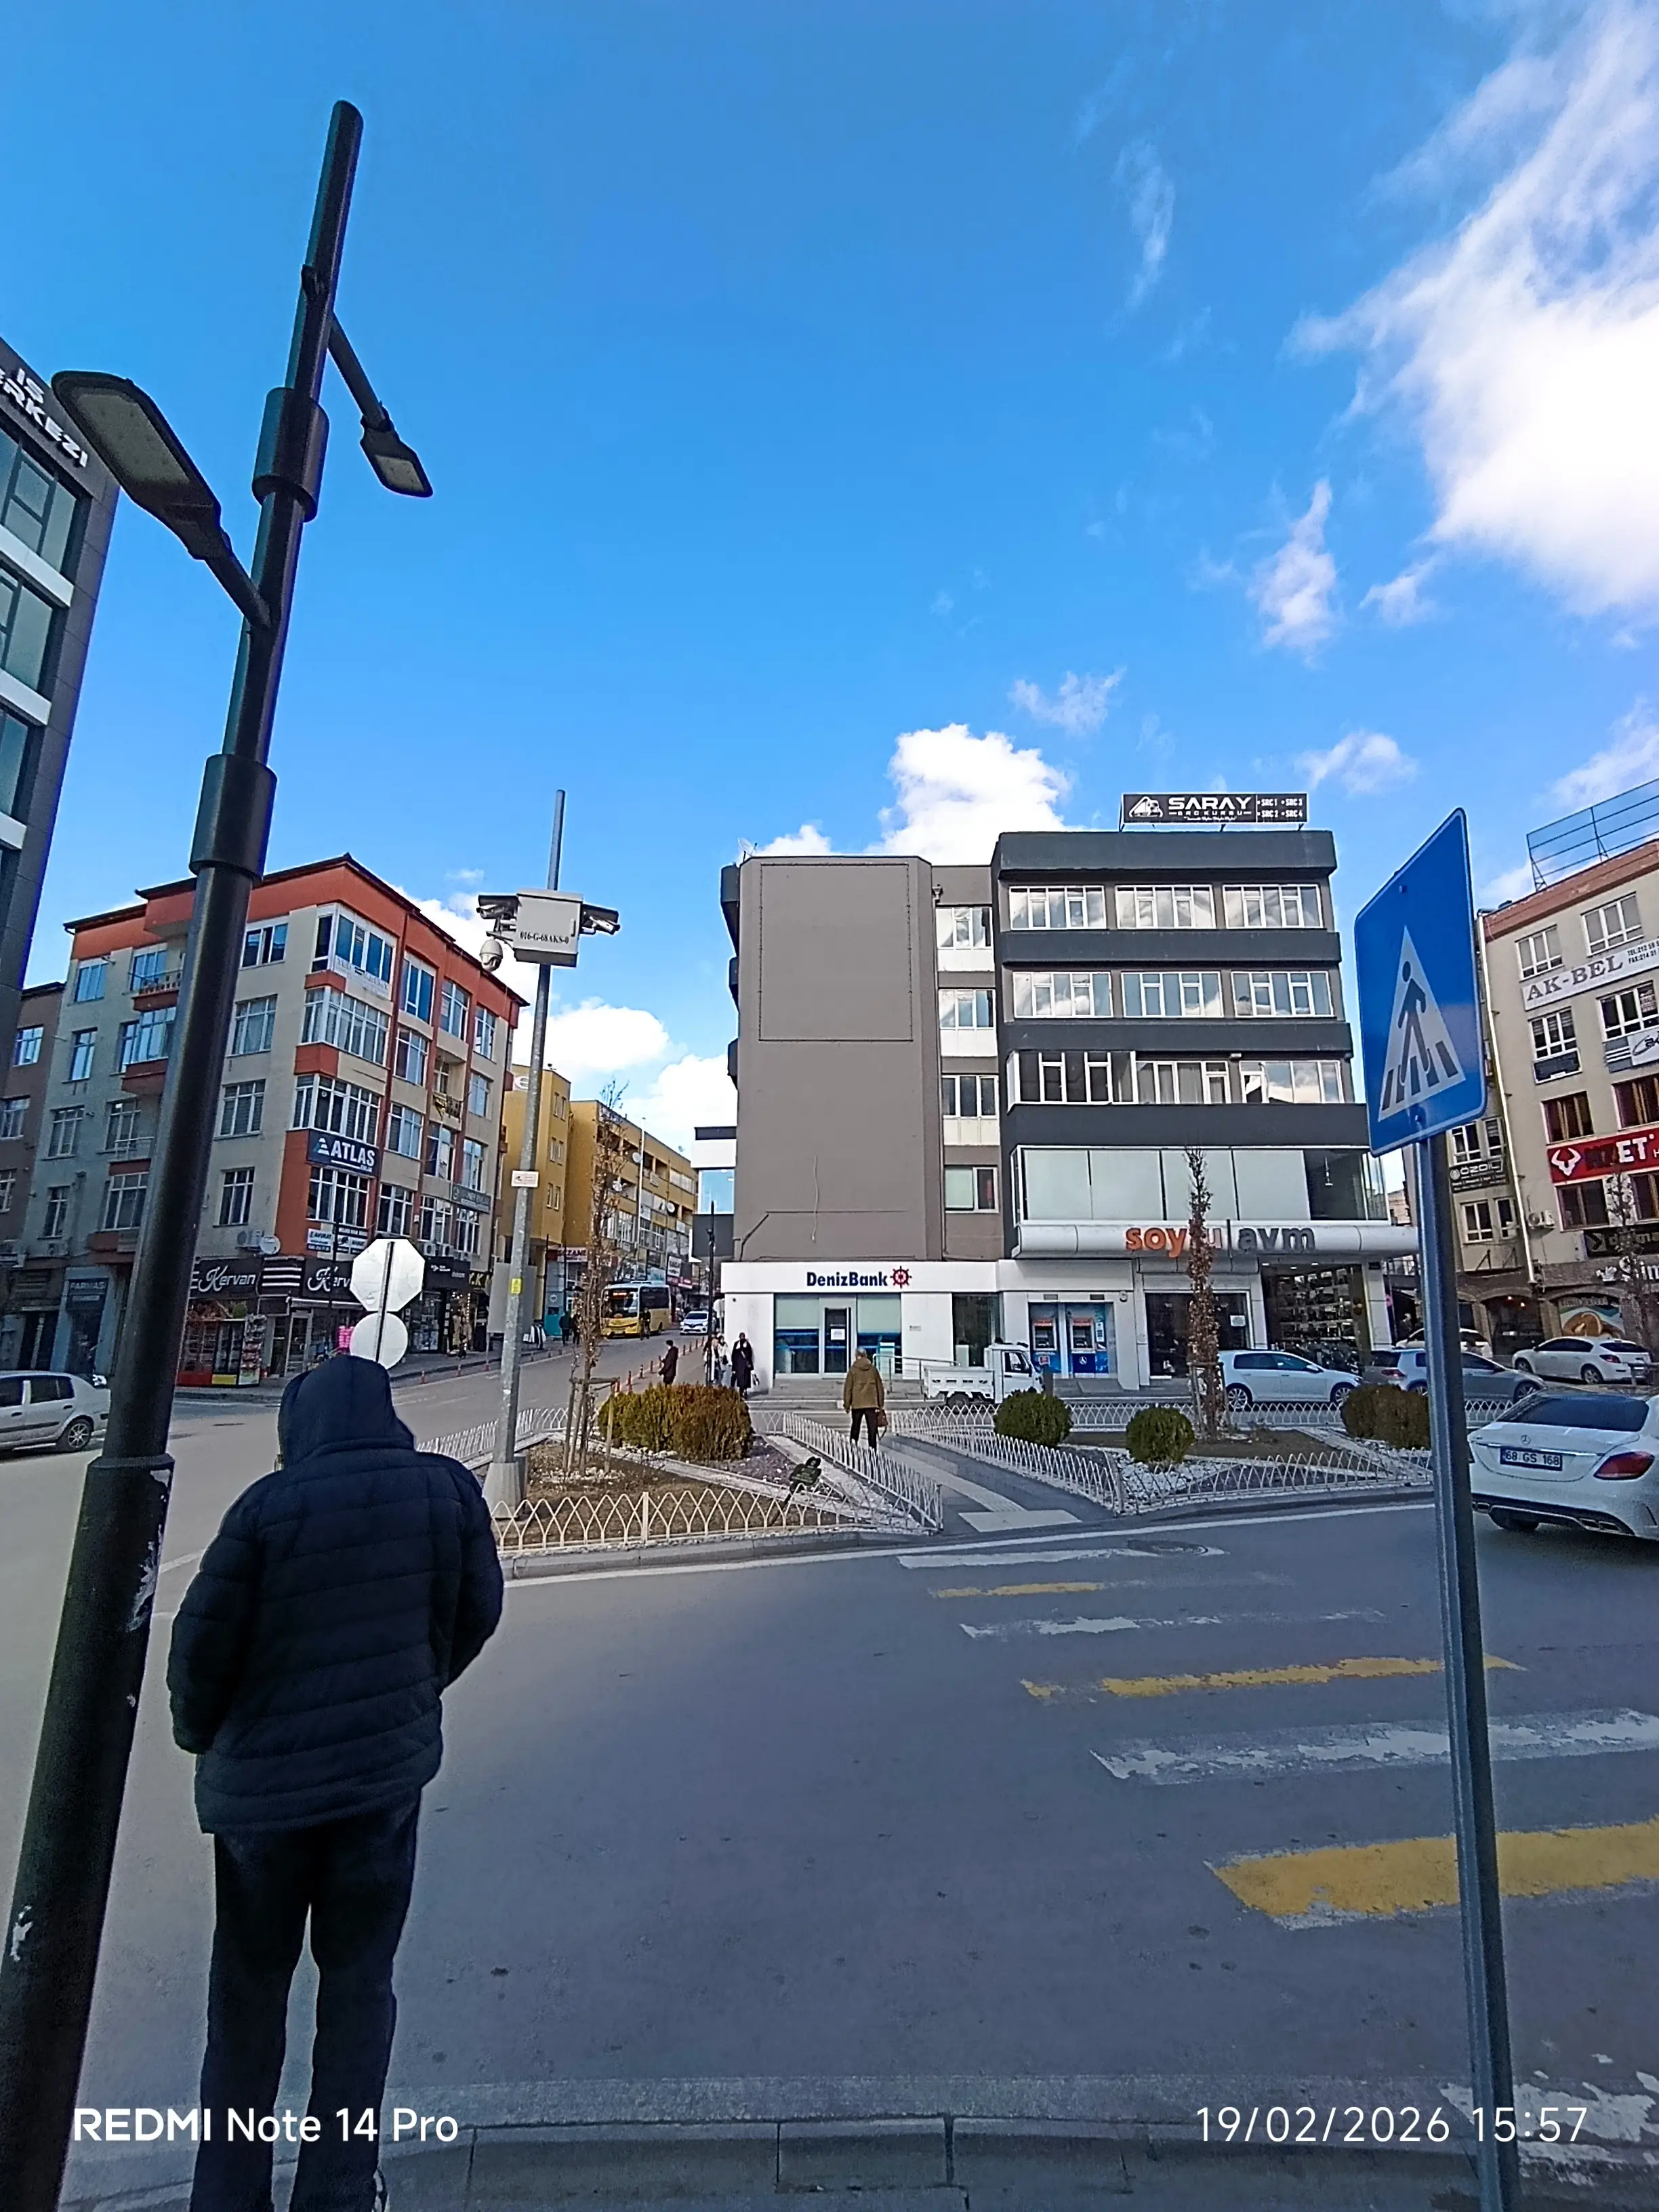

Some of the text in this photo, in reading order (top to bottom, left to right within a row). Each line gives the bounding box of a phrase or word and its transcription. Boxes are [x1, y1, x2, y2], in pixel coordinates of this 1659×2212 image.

[1168, 797, 1252, 810] SARAY
[1527, 956, 1623, 1001] AK-BEL
[330, 1140, 375, 1166] ATLAS
[1126, 1227, 1315, 1258] soyu avm
[198, 1265, 256, 1292] Kervan
[806, 1271, 888, 1286] DenizBank
[1505, 1450, 1559, 1465] 68 GS 168
